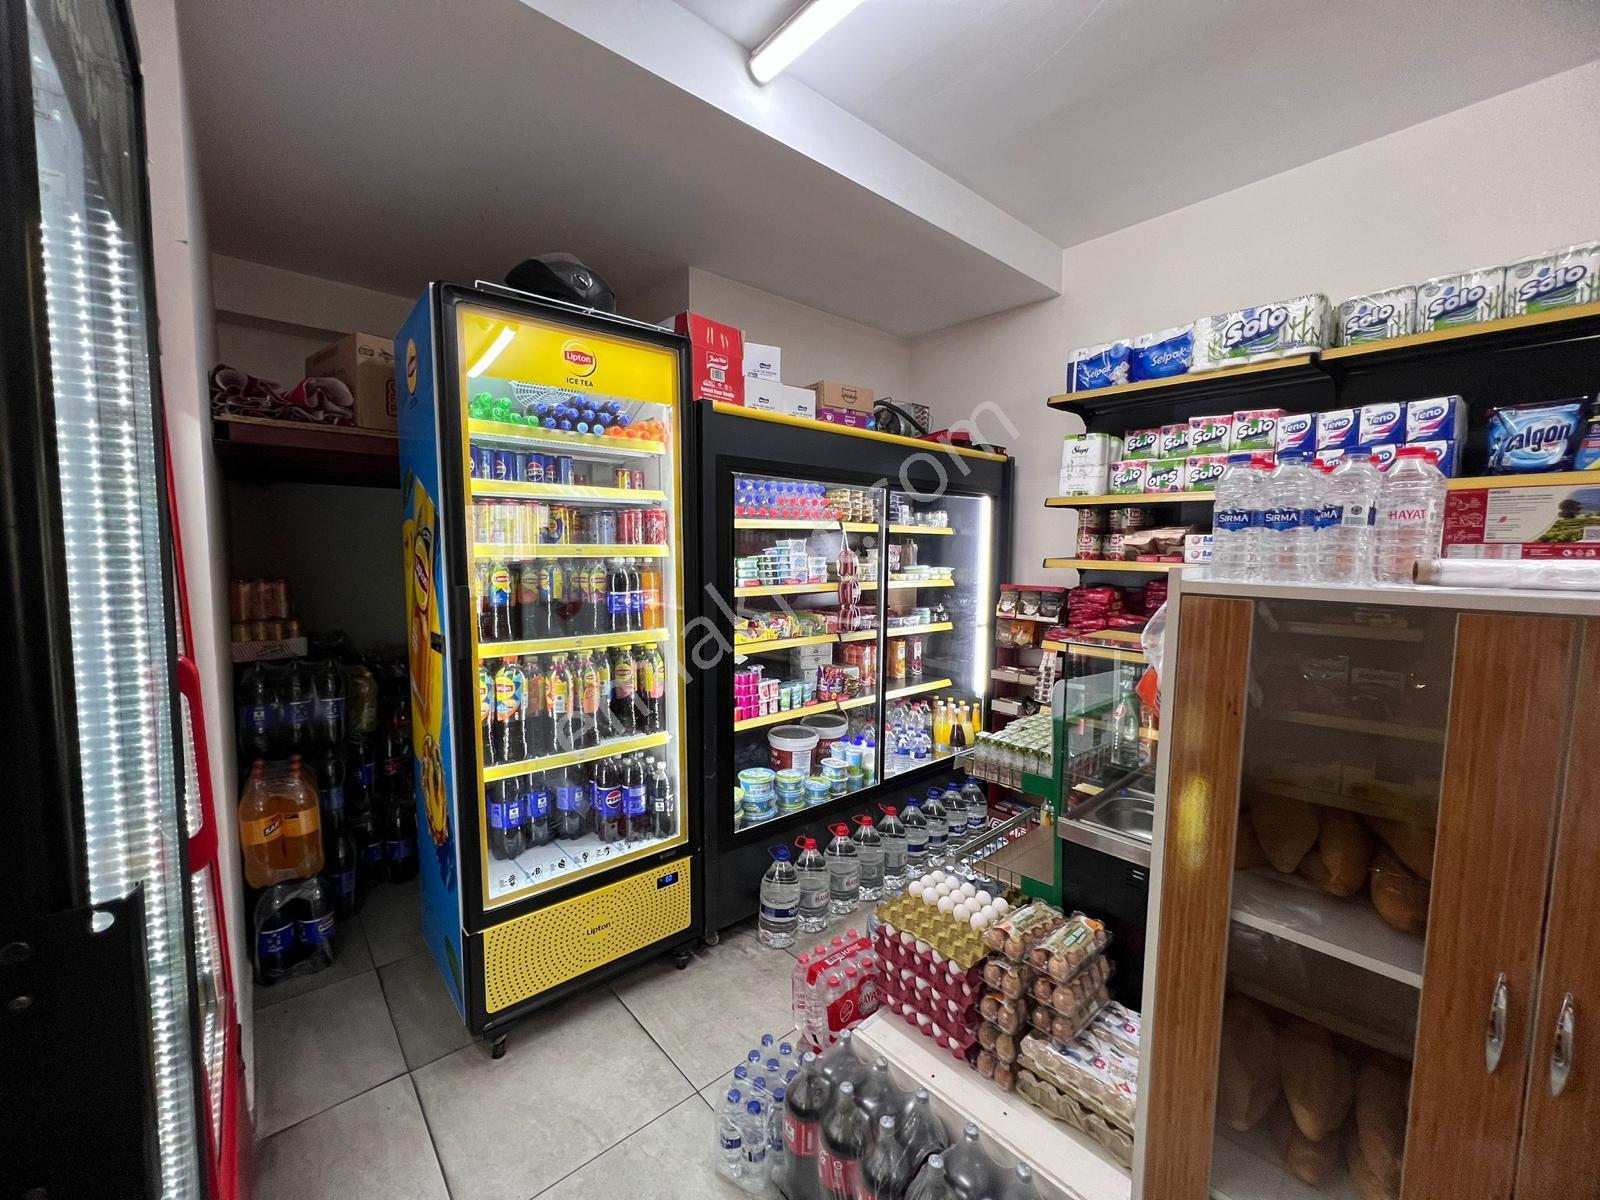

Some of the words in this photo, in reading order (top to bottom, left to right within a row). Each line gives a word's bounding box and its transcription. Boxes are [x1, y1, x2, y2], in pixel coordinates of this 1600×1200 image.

[1519, 265, 1587, 301] Solo
[1428, 286, 1486, 319] Solo
[1223, 306, 1288, 348] Solo
[1346, 304, 1395, 336] Solo
[566, 351, 591, 364] Lipton
[1151, 346, 1188, 367] Selpak
[566, 376, 579, 385] ICE
[579, 378, 594, 388] TEA
[1368, 411, 1395, 425] Teno
[1414, 406, 1443, 421] Teno
[1237, 418, 1274, 440] Solo
[1282, 420, 1306, 434] Teno
[1324, 418, 1349, 431] Teno
[1127, 433, 1156, 451] Solo
[1192, 425, 1227, 445] Solo
[1113, 468, 1141, 486] Solo
[1190, 464, 1224, 483] Solo
[1388, 508, 1427, 521] HAYAT
[586, 921, 611, 936] Lipton
